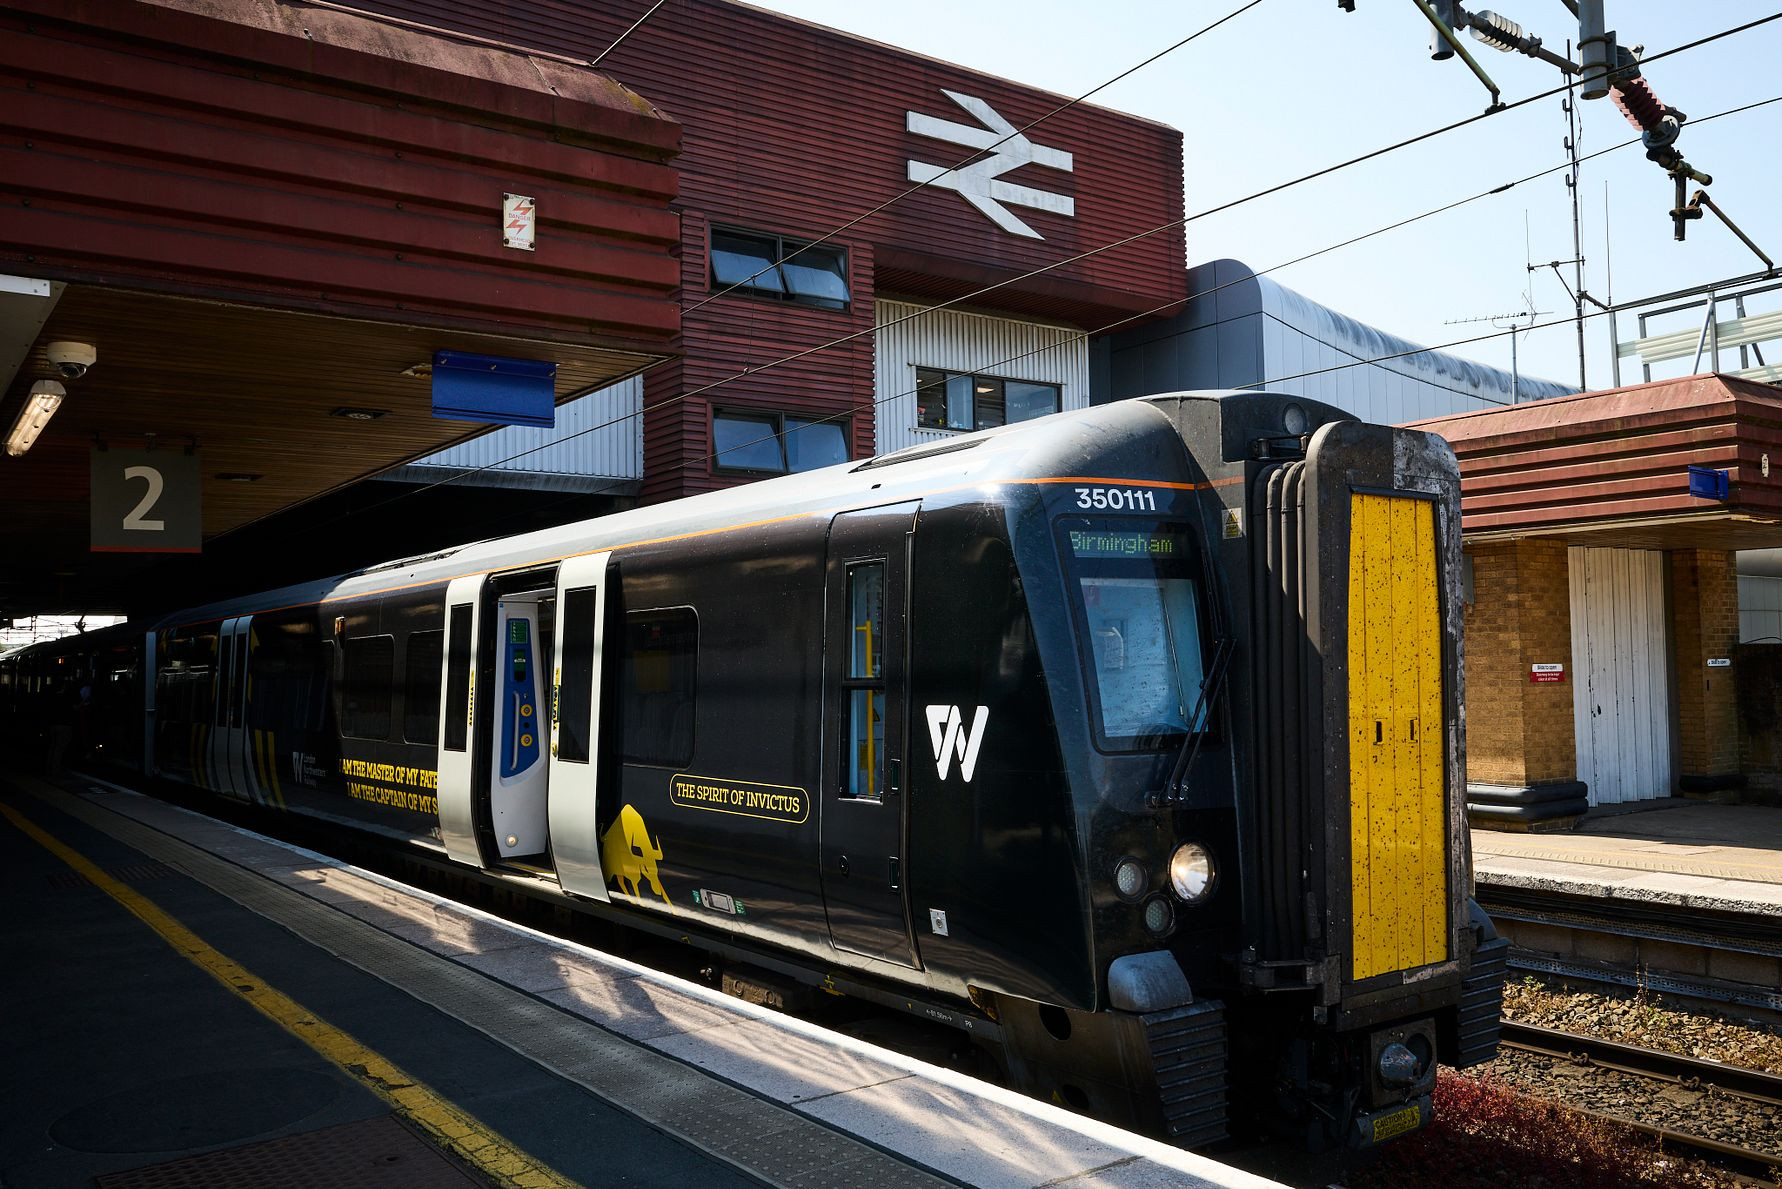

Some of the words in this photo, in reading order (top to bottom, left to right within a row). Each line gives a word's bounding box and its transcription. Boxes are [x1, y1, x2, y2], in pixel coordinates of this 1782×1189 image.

[123, 465, 165, 531] 2
[1074, 488, 1156, 511] 350111
[1069, 531, 1173, 554] Birmingham
[925, 704, 990, 783] W
[342, 758, 353, 775] AM
[353, 760, 366, 777] THE
[366, 762, 395, 782] MASTER
[395, 766, 406, 784] OF
[406, 767, 419, 786] MY
[420, 769, 438, 789] FATE
[351, 782, 361, 799] AM
[361, 784, 376, 802] THE
[375, 786, 408, 809] CAPTAIN
[408, 792, 418, 811] OF
[419, 794, 432, 814] MY
[676, 782, 695, 799] THE
[696, 785, 729, 804] SPIRIT
[730, 789, 745, 806] OF
[746, 792, 800, 814] INVICTUS
